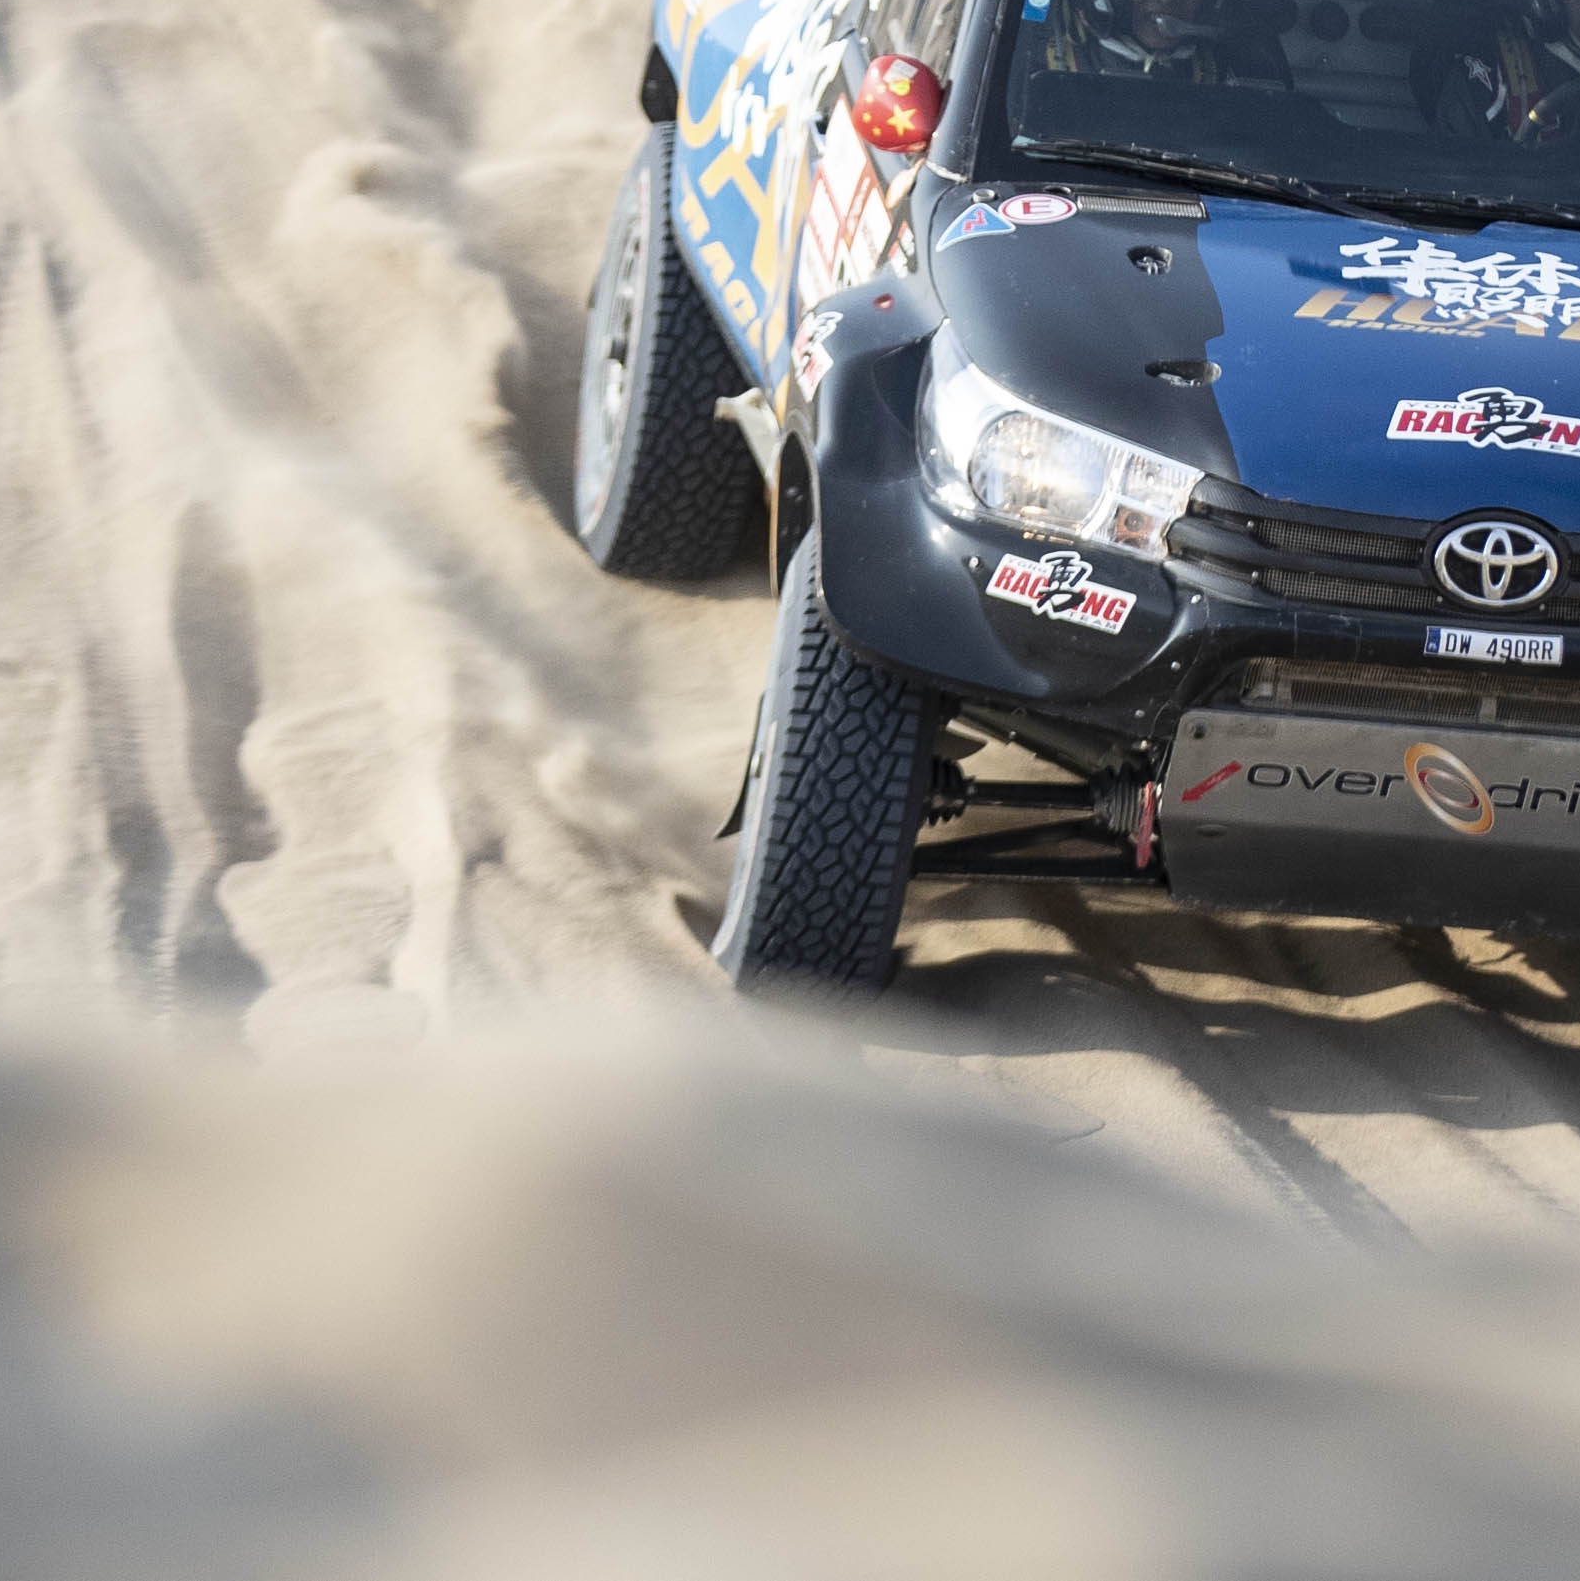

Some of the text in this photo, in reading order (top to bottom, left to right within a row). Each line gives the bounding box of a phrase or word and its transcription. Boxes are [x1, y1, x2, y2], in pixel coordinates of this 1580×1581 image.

[1445, 632, 1472, 655] DW
[1486, 637, 1554, 661] 490RR
[1246, 761, 1406, 798] over
